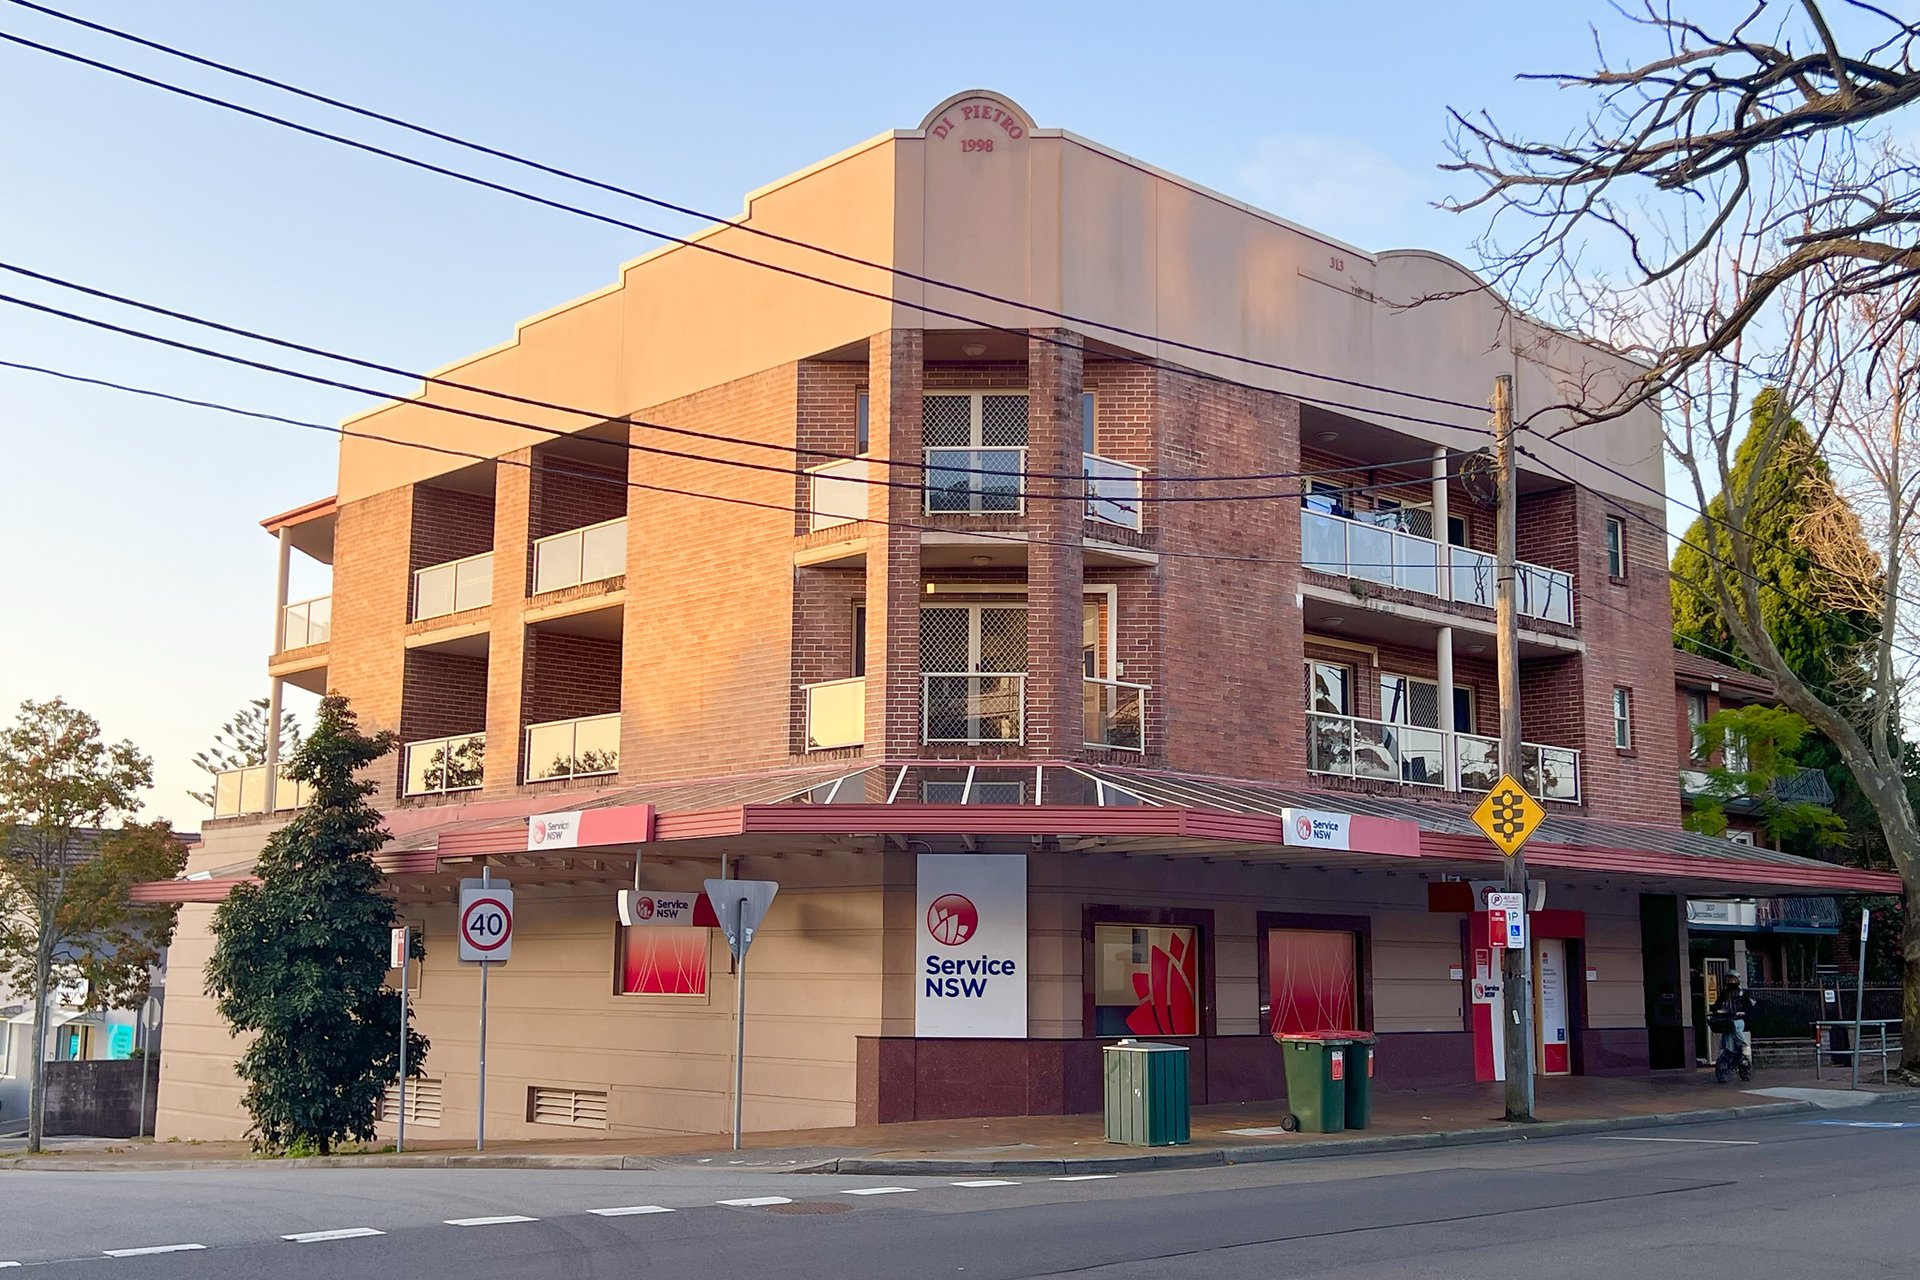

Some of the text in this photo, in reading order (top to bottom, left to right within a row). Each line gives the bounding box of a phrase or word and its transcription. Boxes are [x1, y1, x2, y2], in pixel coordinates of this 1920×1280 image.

[932, 105, 1023, 139] DI PIETRO
[961, 139, 994, 152] 1998
[1329, 257, 1344, 271] 313
[547, 821, 569, 831] Service
[1313, 820, 1339, 831] Service
[547, 831, 563, 840] NSW
[1313, 830, 1331, 840] NSW
[657, 899, 688, 909] Service
[657, 909, 678, 918] NSW
[1508, 912, 1518, 921] 1P
[470, 913, 502, 936] 40
[926, 955, 1016, 976] Service
[926, 978, 987, 998] NSW
